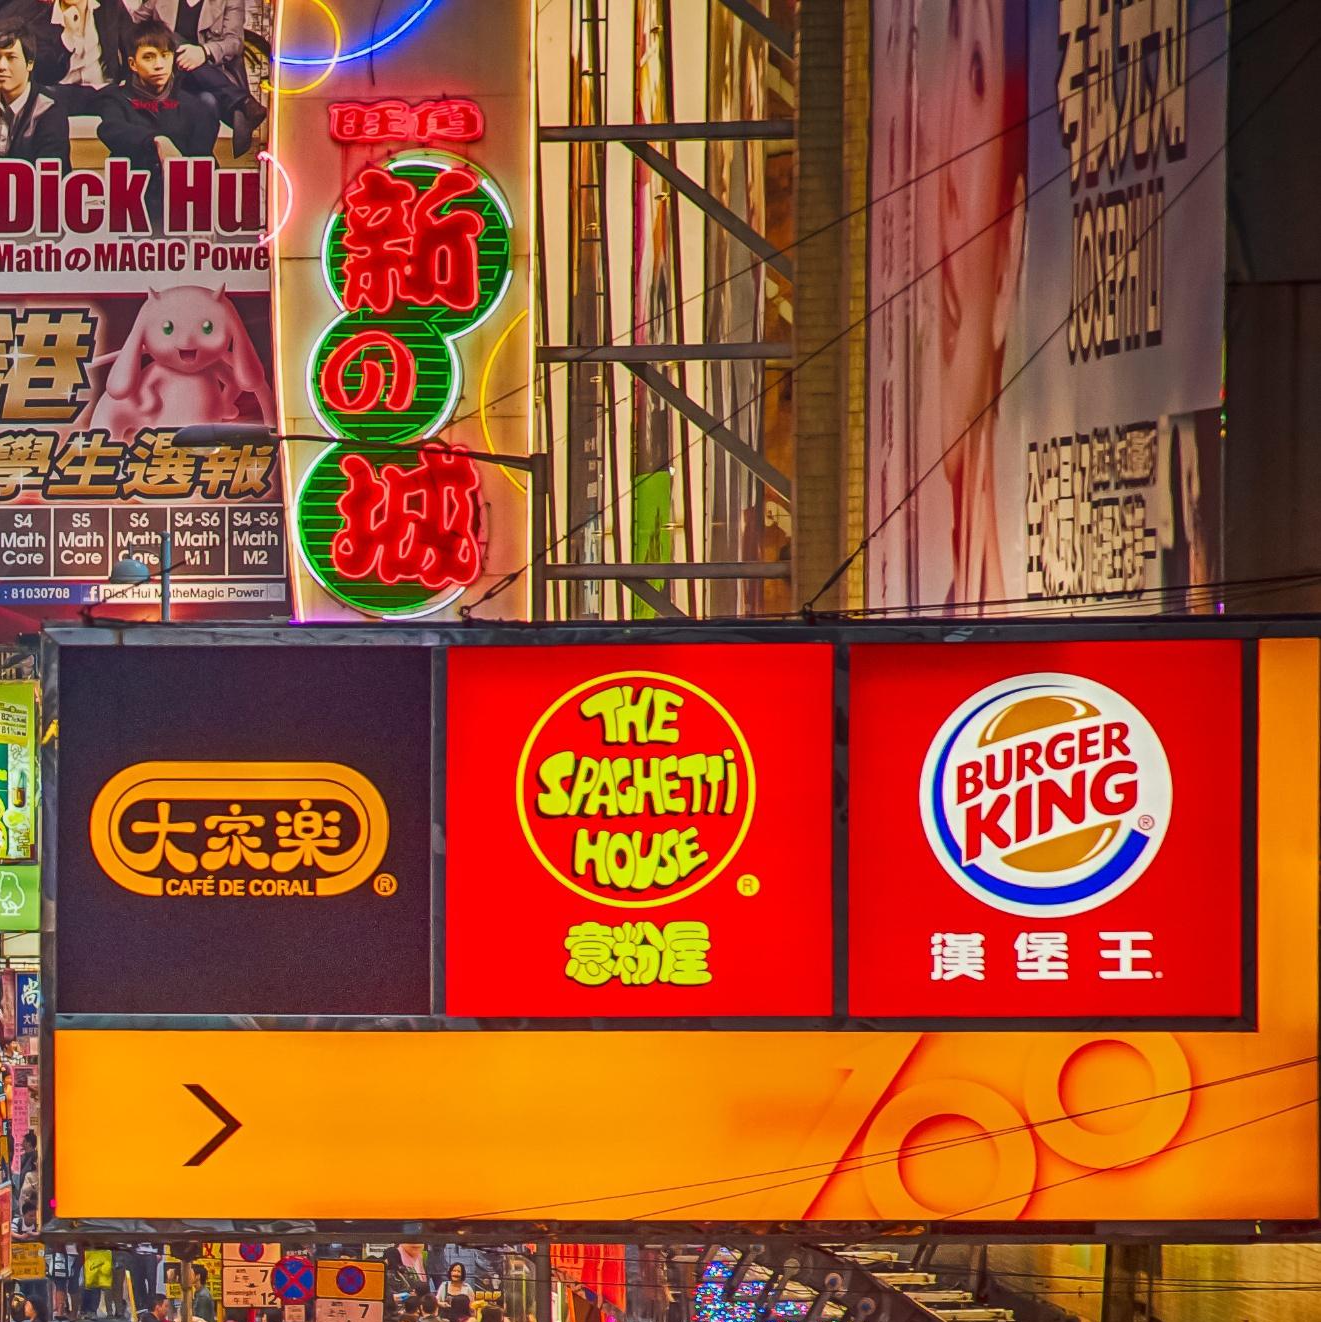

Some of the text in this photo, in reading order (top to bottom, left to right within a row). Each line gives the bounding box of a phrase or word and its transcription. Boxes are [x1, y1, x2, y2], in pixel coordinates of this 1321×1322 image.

[14, 513, 33, 528] S4
[72, 513, 91, 528] S5
[129, 512, 149, 528] S6
[175, 512, 220, 528] S4-S6
[233, 512, 278, 527] S4-S6
[0, 533, 46, 549] Math
[58, 533, 104, 549] Math
[117, 532, 162, 549] Math
[175, 532, 220, 548] Math
[233, 531, 278, 547] Math
[2, 551, 44, 566] Core
[60, 551, 102, 566] Core
[243, 550, 268, 565] M2
[11, 587, 70, 600] 81030708
[228, 587, 264, 599] Power
[581, 686, 684, 744] THE
[956, 722, 1130, 805] BURGER
[961, 761, 1138, 866] KING
[575, 828, 709, 890] HOUSE
[219, 880, 245, 896] DE
[249, 880, 315, 896] CORAL
[565, 920, 712, 987] 意粉屋
[930, 931, 1154, 981] 漢堡王
[358, 1304, 370, 1319] 7
